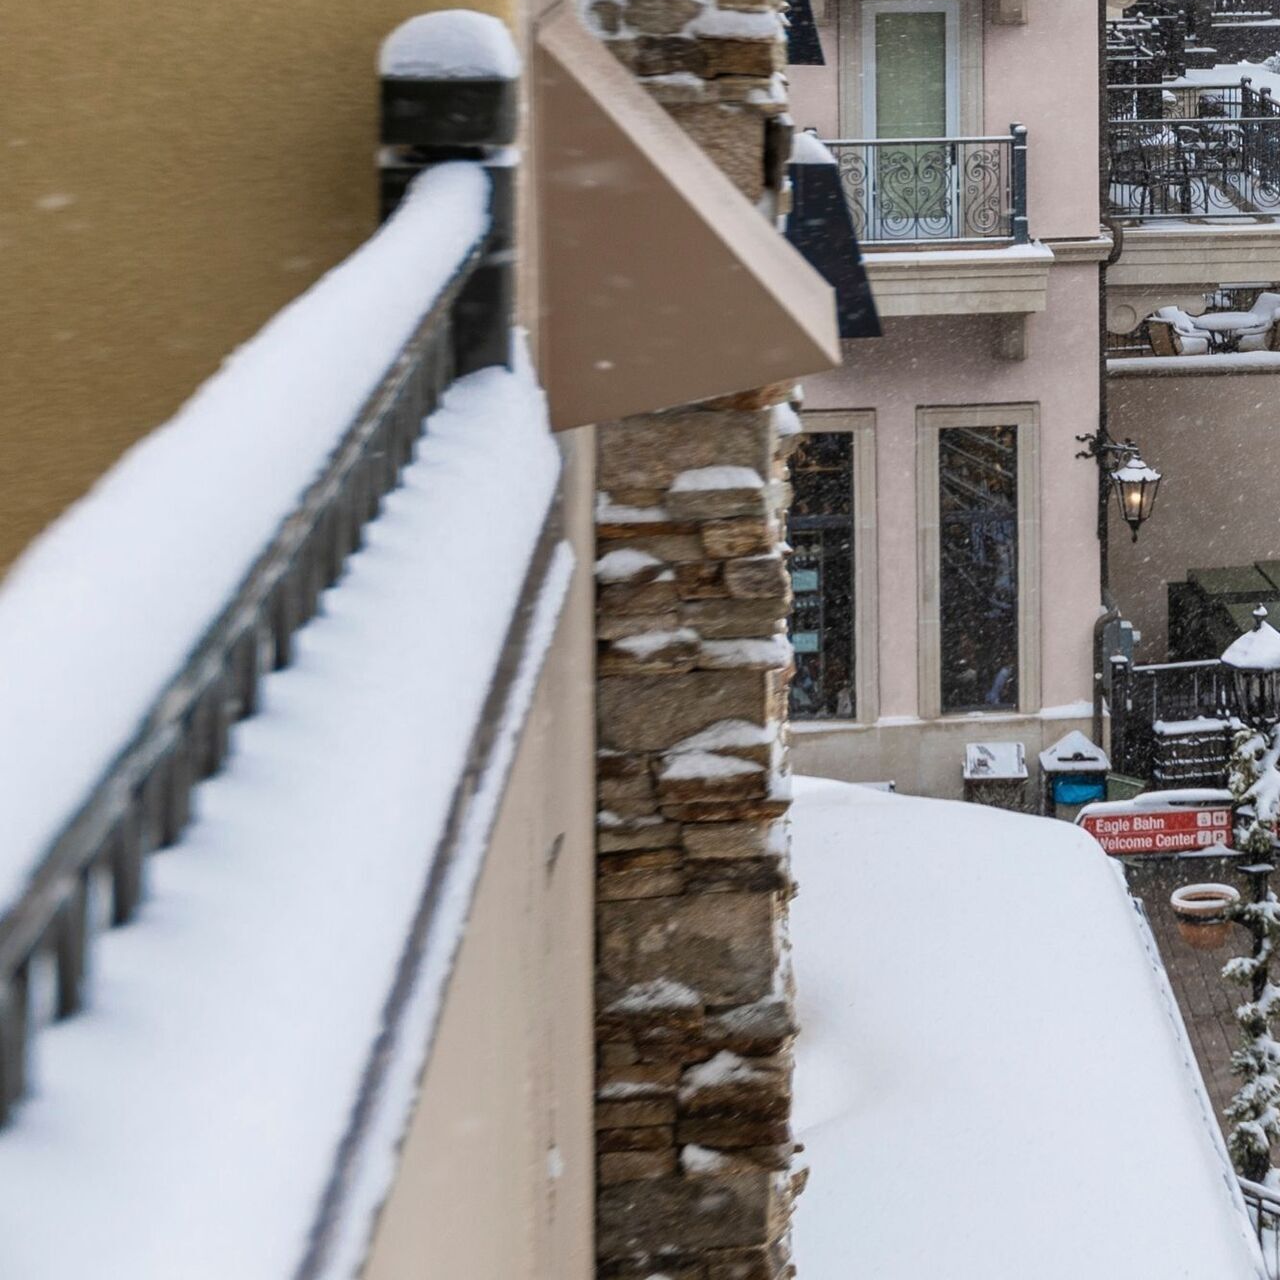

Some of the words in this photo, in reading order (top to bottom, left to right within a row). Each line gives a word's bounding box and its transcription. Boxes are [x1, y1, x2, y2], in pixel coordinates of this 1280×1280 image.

[1096, 819, 1129, 834] Eagle
[1133, 817, 1164, 831] Bahn
[1156, 833, 1196, 847] Center
